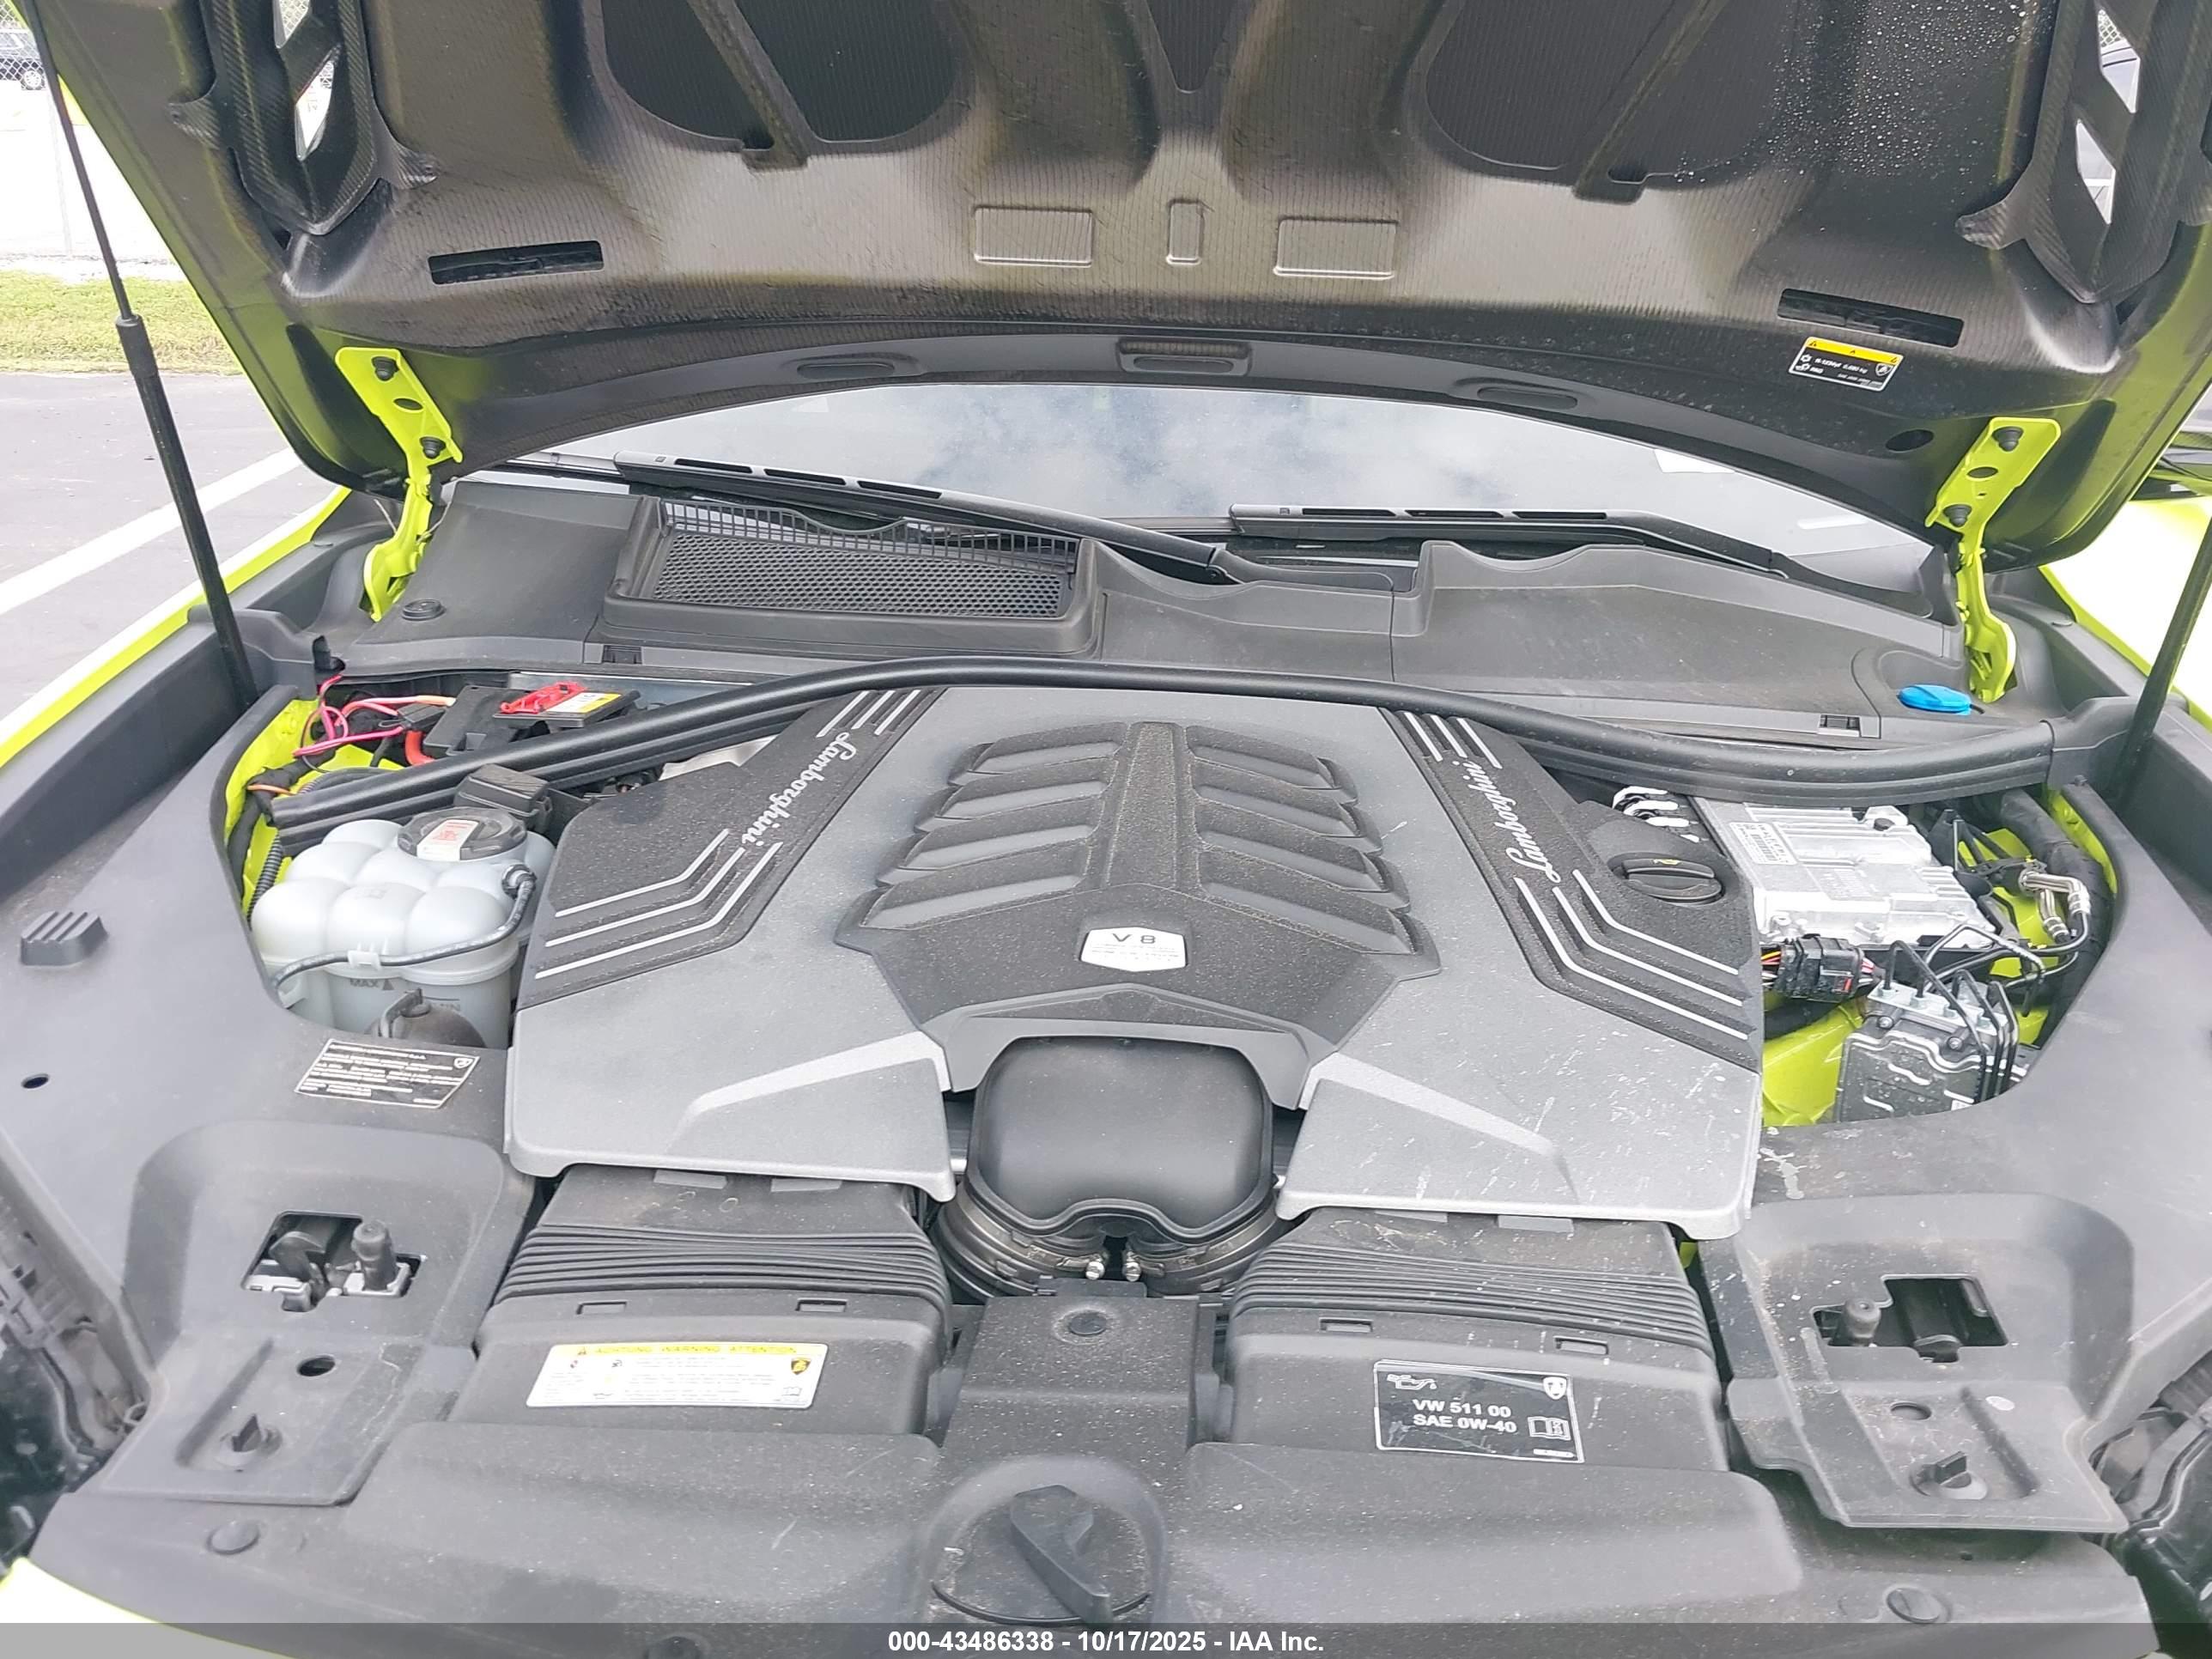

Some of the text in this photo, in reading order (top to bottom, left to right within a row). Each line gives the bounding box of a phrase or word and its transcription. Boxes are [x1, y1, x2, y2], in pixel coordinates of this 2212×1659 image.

[742, 732, 857, 847] Lamborghini
[1452, 761, 1561, 883] Lamborghini
[349, 978, 379, 988] MAX
[659, 1345, 720, 1353] WARNING
[729, 1345, 797, 1354] ATTENTION
[1413, 1399, 1511, 1418] VW 511 00
[1413, 1414, 1517, 1433] SAE 0W-40
